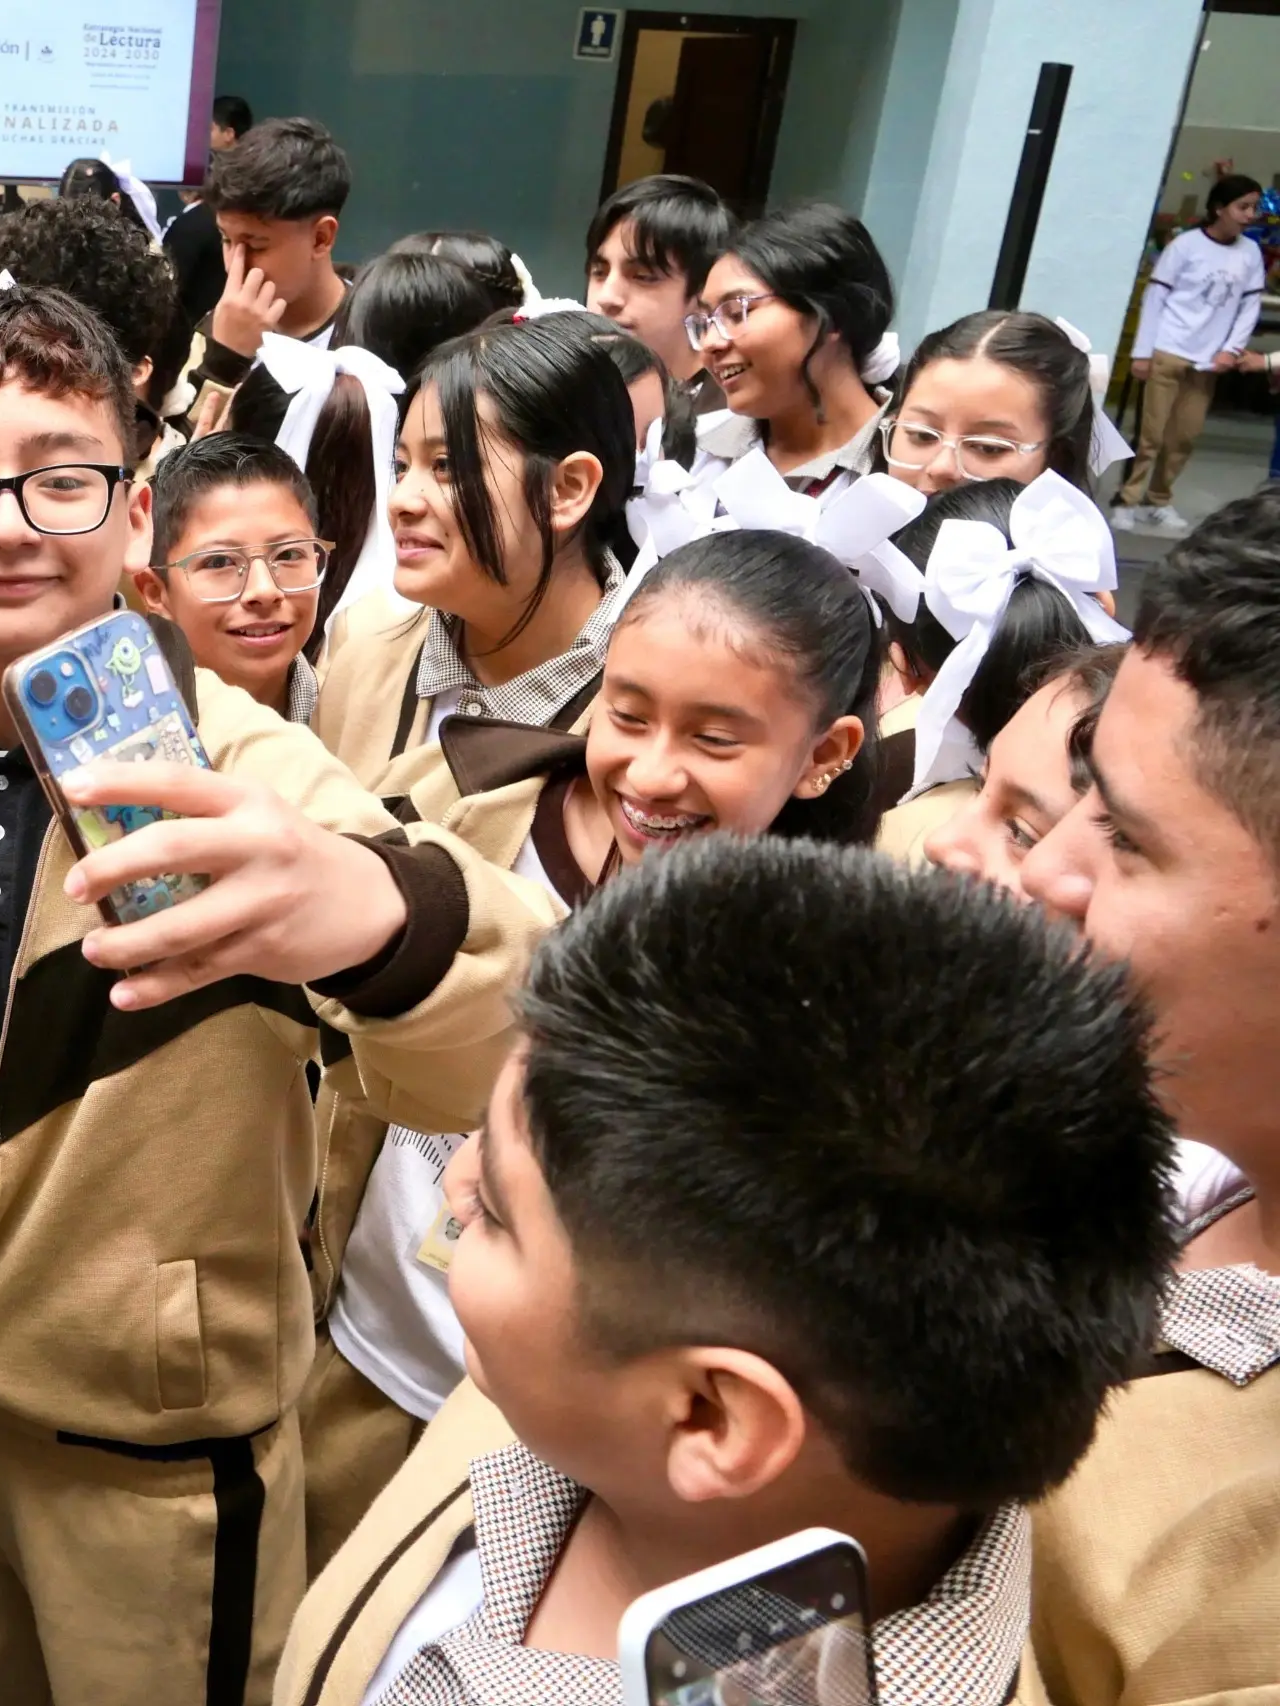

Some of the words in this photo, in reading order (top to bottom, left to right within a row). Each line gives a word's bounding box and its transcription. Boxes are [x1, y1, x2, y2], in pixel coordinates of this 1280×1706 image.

[100, 33, 161, 48] Lectura
[4, 103, 96, 115] TRANSMISIÓN
[51, 135, 105, 145] GRACIAS
